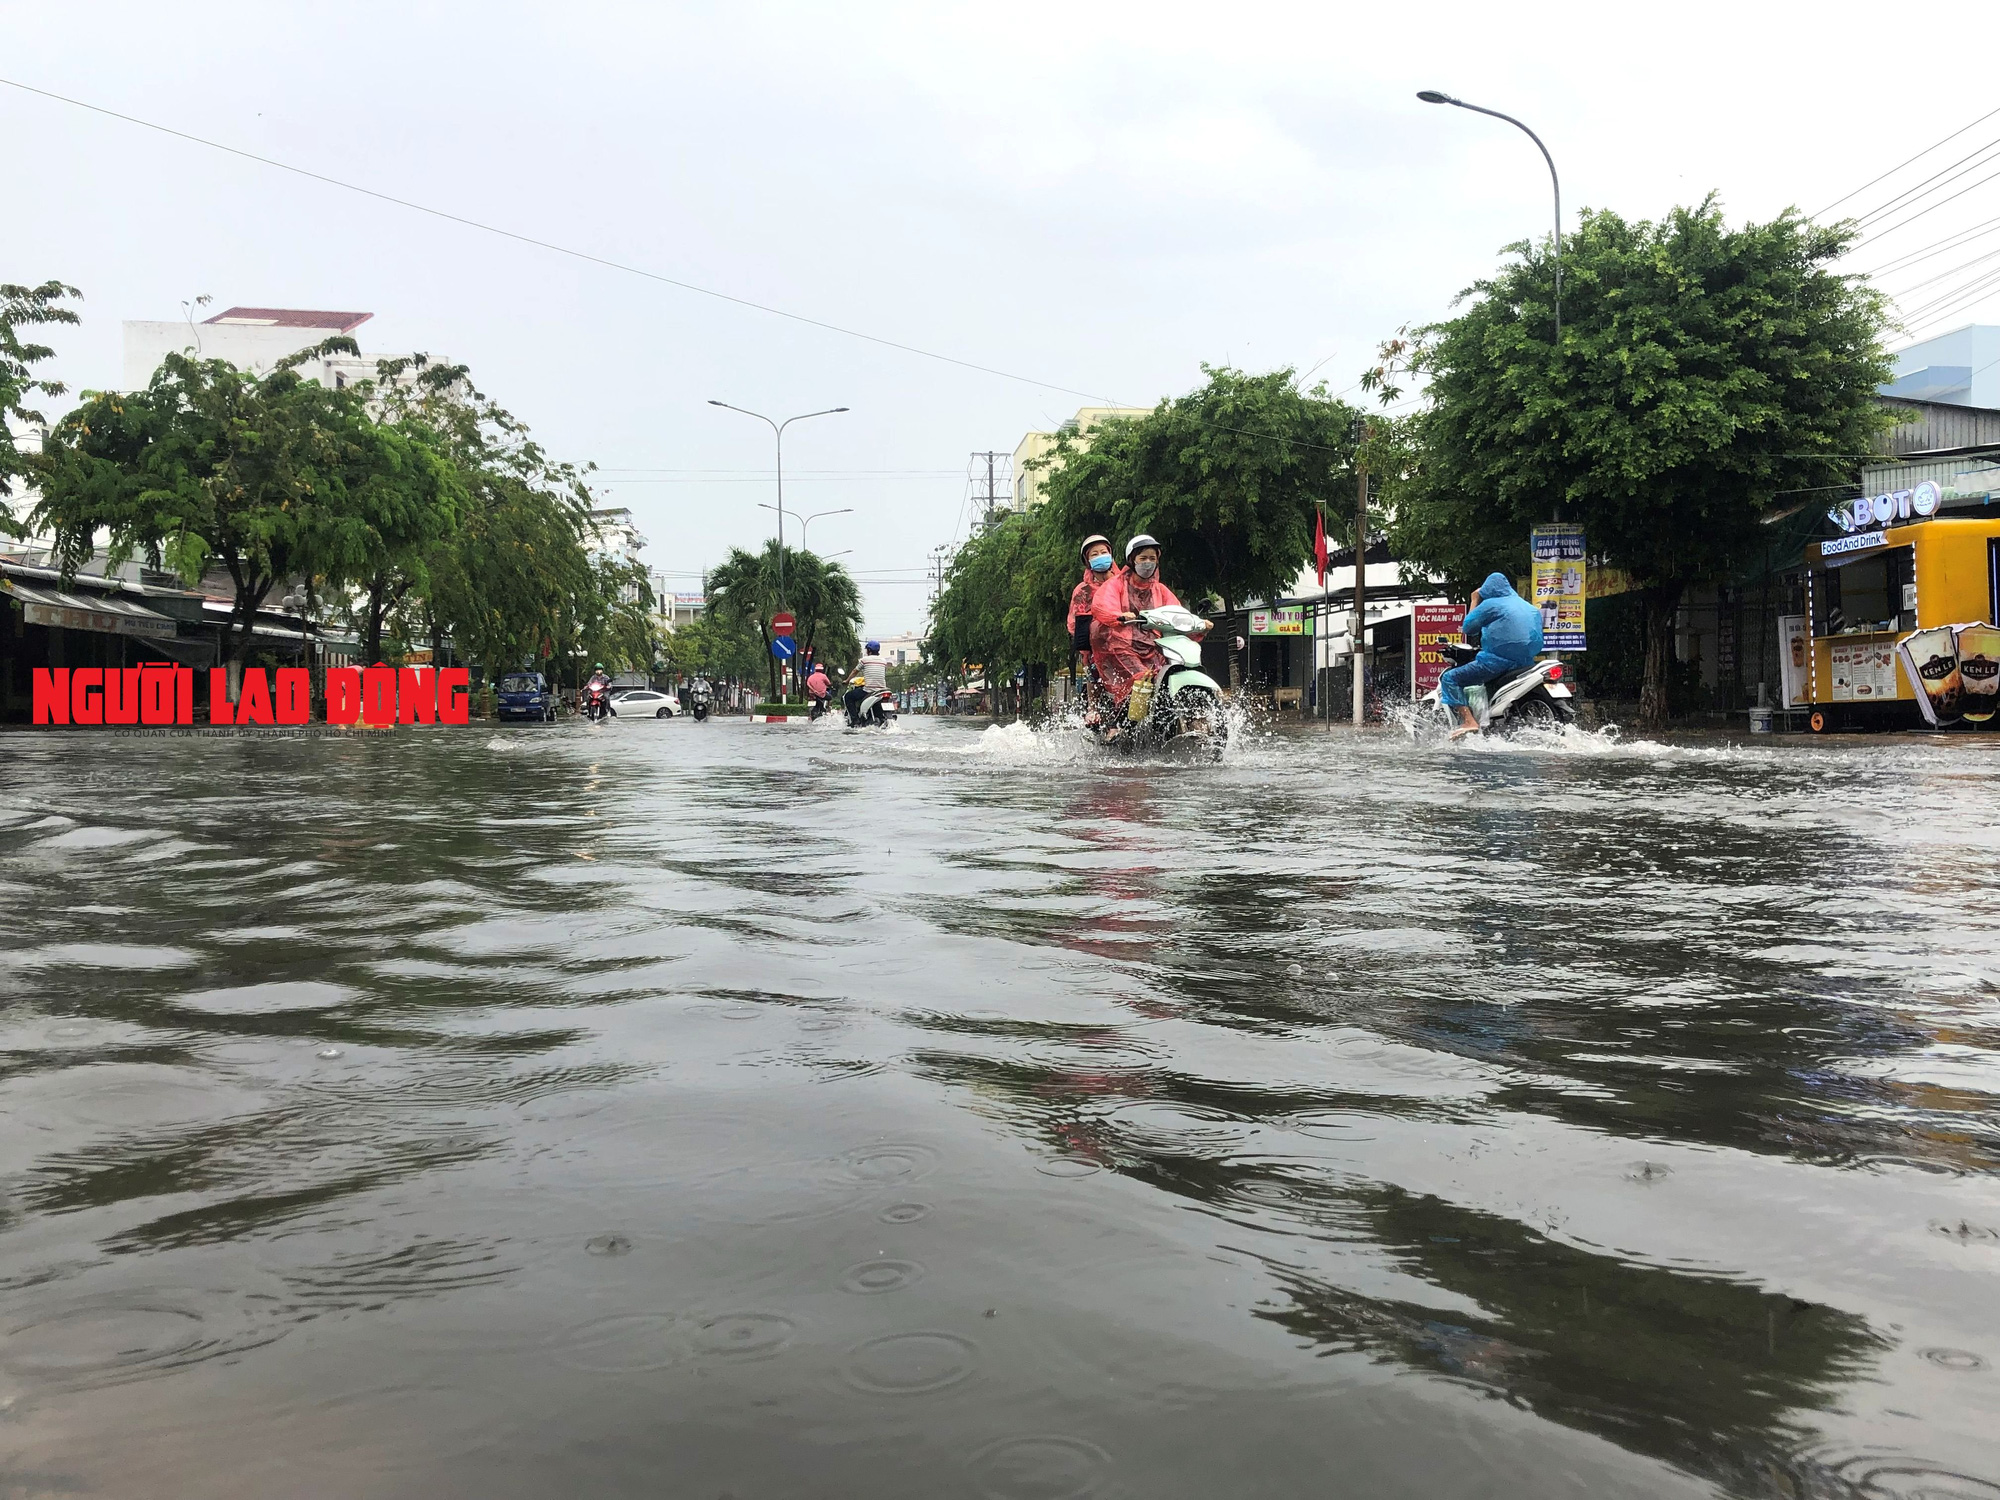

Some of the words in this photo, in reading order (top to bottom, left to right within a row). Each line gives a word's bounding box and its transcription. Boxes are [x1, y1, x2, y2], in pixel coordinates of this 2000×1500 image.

[1537, 538, 1553, 547] GIẢI
[1822, 542, 1842, 553] Food
[1842, 537, 1859, 550] And
[1860, 533, 1881, 547] Drink
[1271, 610, 1285, 623] NỘI
[1287, 612, 1293, 621] Y
[1416, 613, 1430, 622] TÓC
[1431, 614, 1447, 622] NAM
[1452, 613, 1463, 621] NỮ
[1923, 664, 1942, 677] KEN
[1963, 665, 1982, 674] KEN
